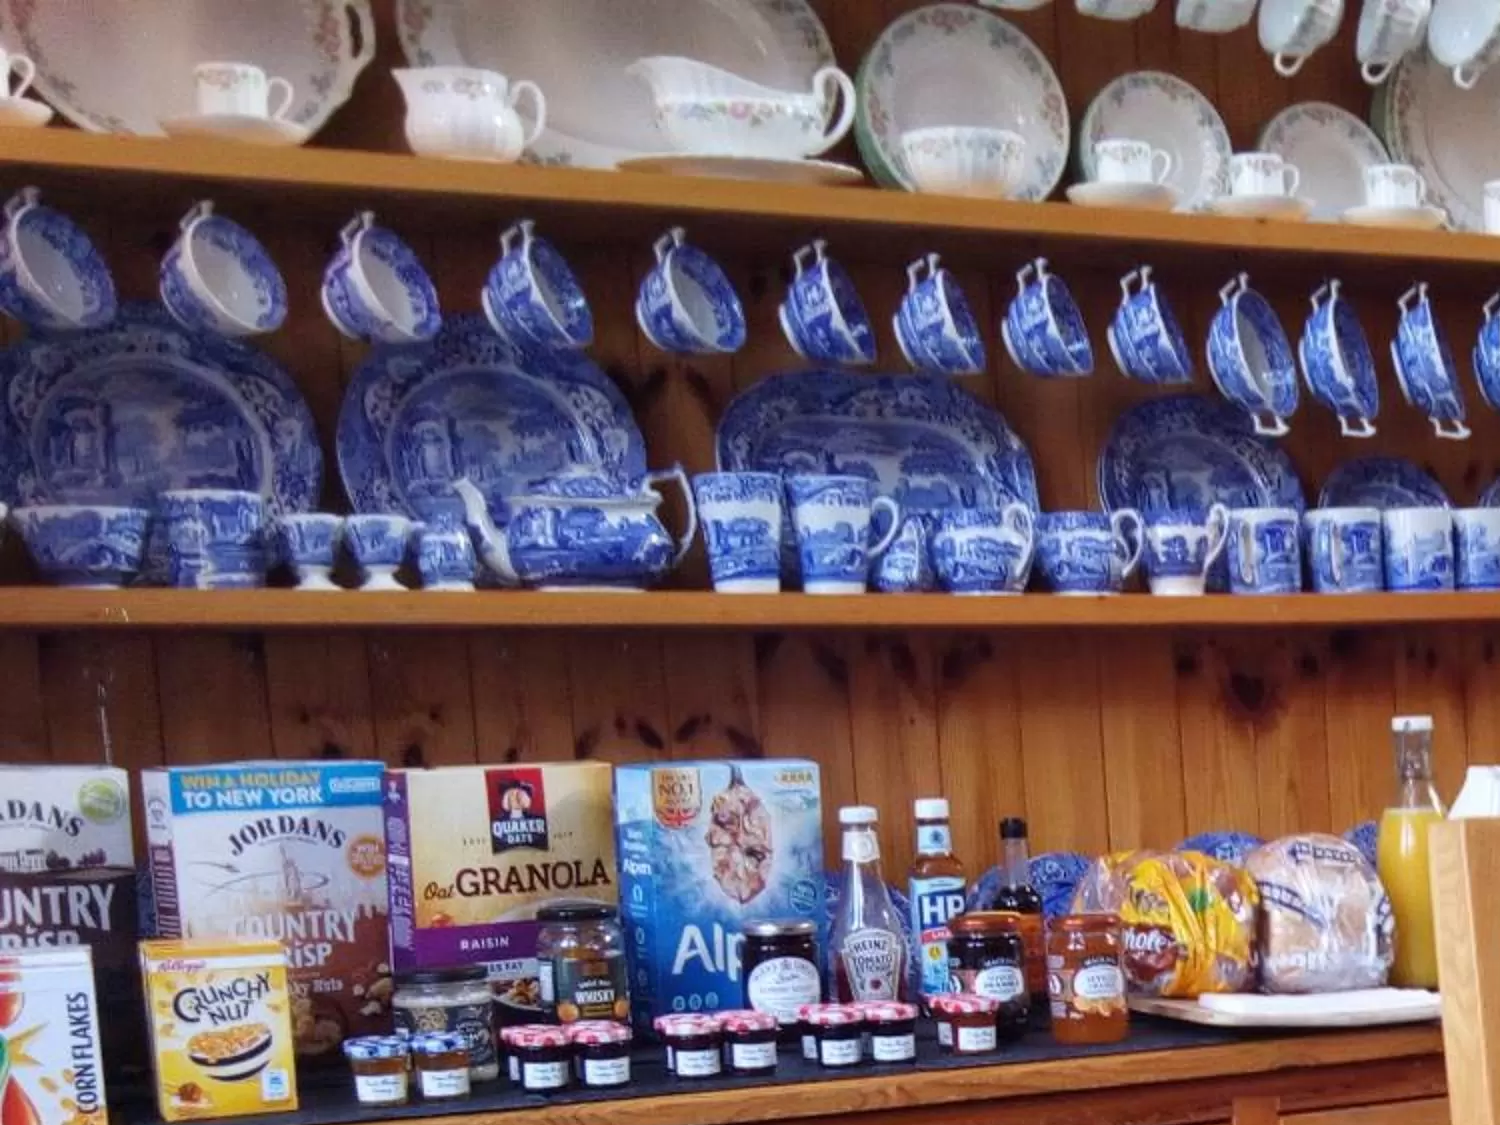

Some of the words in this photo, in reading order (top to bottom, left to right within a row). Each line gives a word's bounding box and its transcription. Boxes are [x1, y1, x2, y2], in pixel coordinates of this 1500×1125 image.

[181, 774, 219, 789] WIN
[222, 773, 234, 788] A
[240, 769, 321, 788] HOLIDAY
[182, 791, 211, 809] TO
[215, 789, 262, 807] NEW
[266, 786, 324, 804] YORK
[228, 814, 347, 856] JORDANS
[492, 818, 546, 838] QUAKER
[424, 881, 456, 900] Oat
[456, 859, 611, 897] GRANOLA
[921, 895, 965, 925] HP
[230, 910, 357, 943] COUNTRY
[460, 936, 510, 951] RAISIN
[672, 922, 746, 982] Alp
[853, 939, 888, 952] HEINZ
[852, 954, 893, 967] TOMATO
[173, 972, 271, 1023] CRUNCHY
[66, 991, 94, 1061] FLAKES
[207, 1000, 256, 1026] NUT
[73, 1062, 99, 1114] CORN
